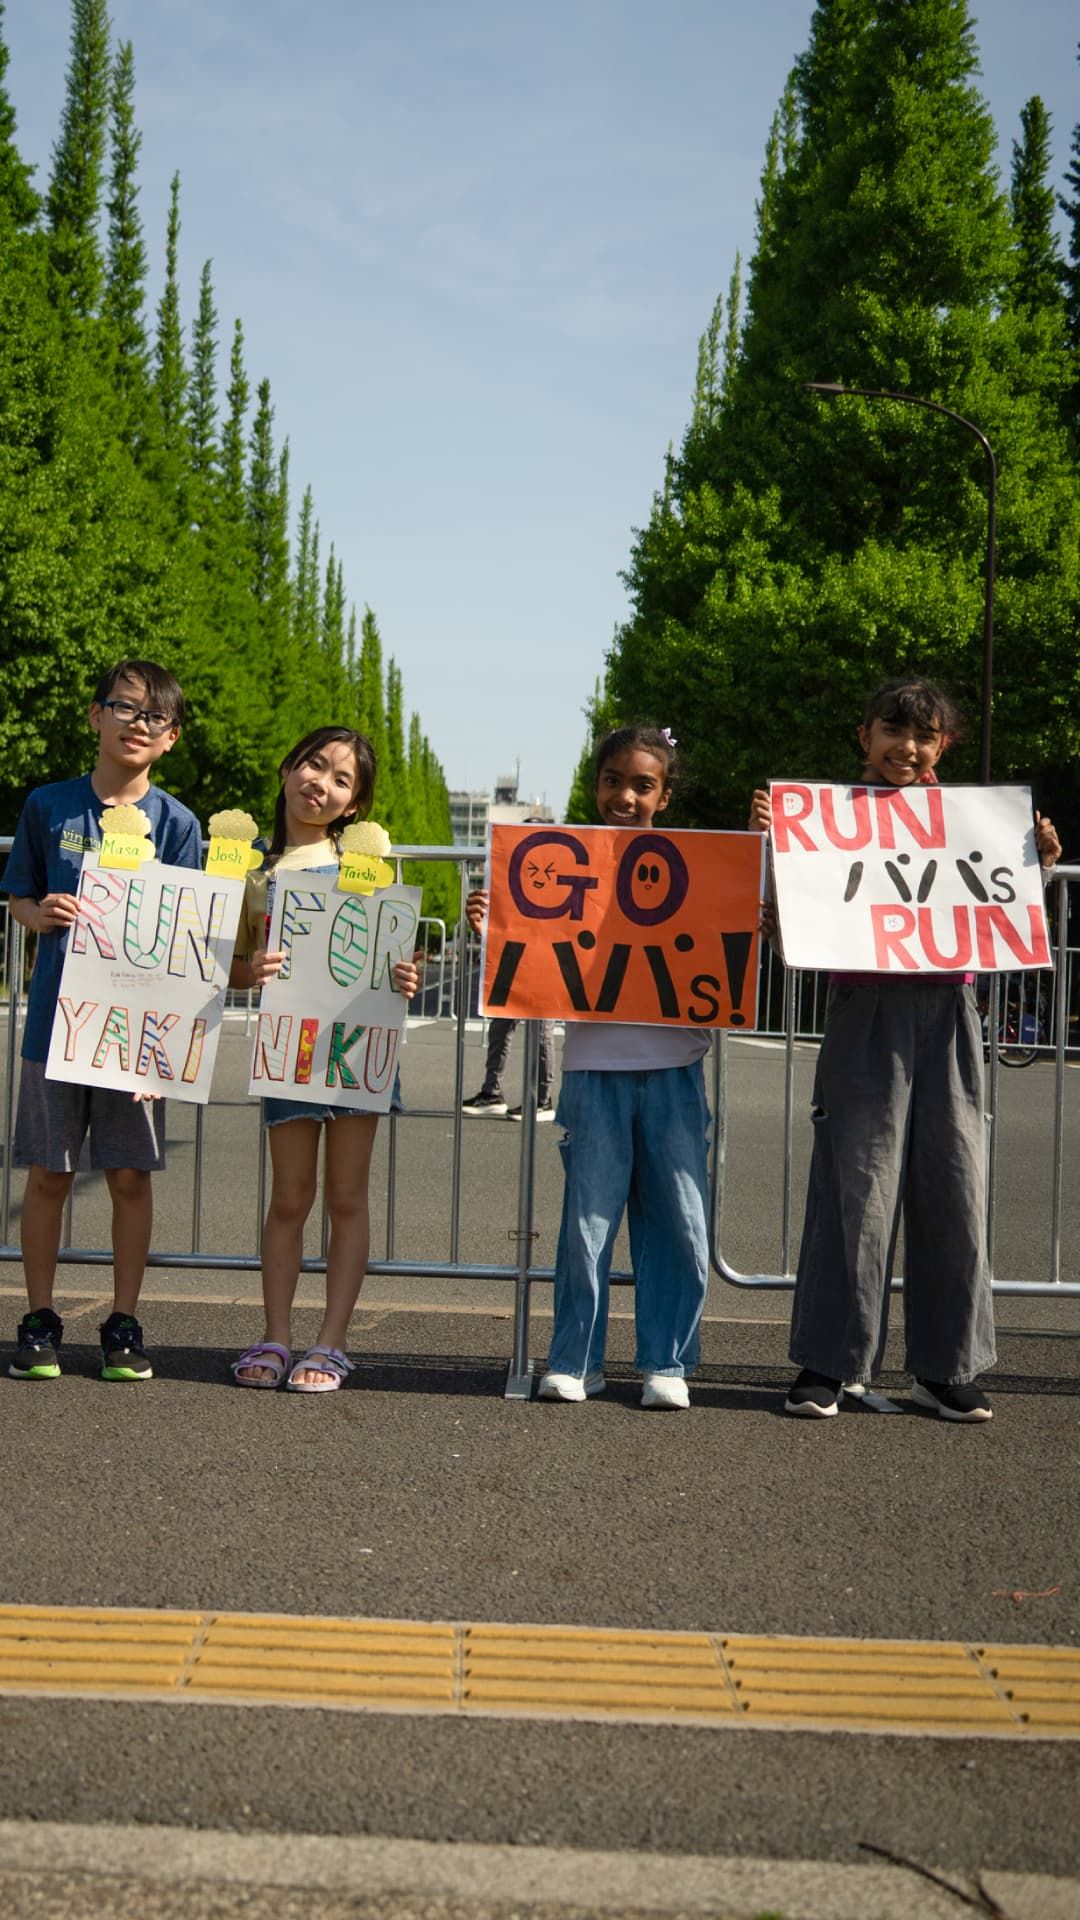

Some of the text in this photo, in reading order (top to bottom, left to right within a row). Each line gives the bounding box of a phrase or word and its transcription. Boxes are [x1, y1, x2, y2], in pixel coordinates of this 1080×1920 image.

[103, 839, 140, 856] Masa
[210, 845, 243, 864] Josh
[771, 784, 946, 853] RUN
[508, 831, 690, 927] GO
[72, 869, 228, 983] RUN
[278, 889, 416, 993] FOR
[870, 904, 1051, 970] RUN
[58, 997, 207, 1084] YAKI
[252, 1012, 399, 1095] NIKU
